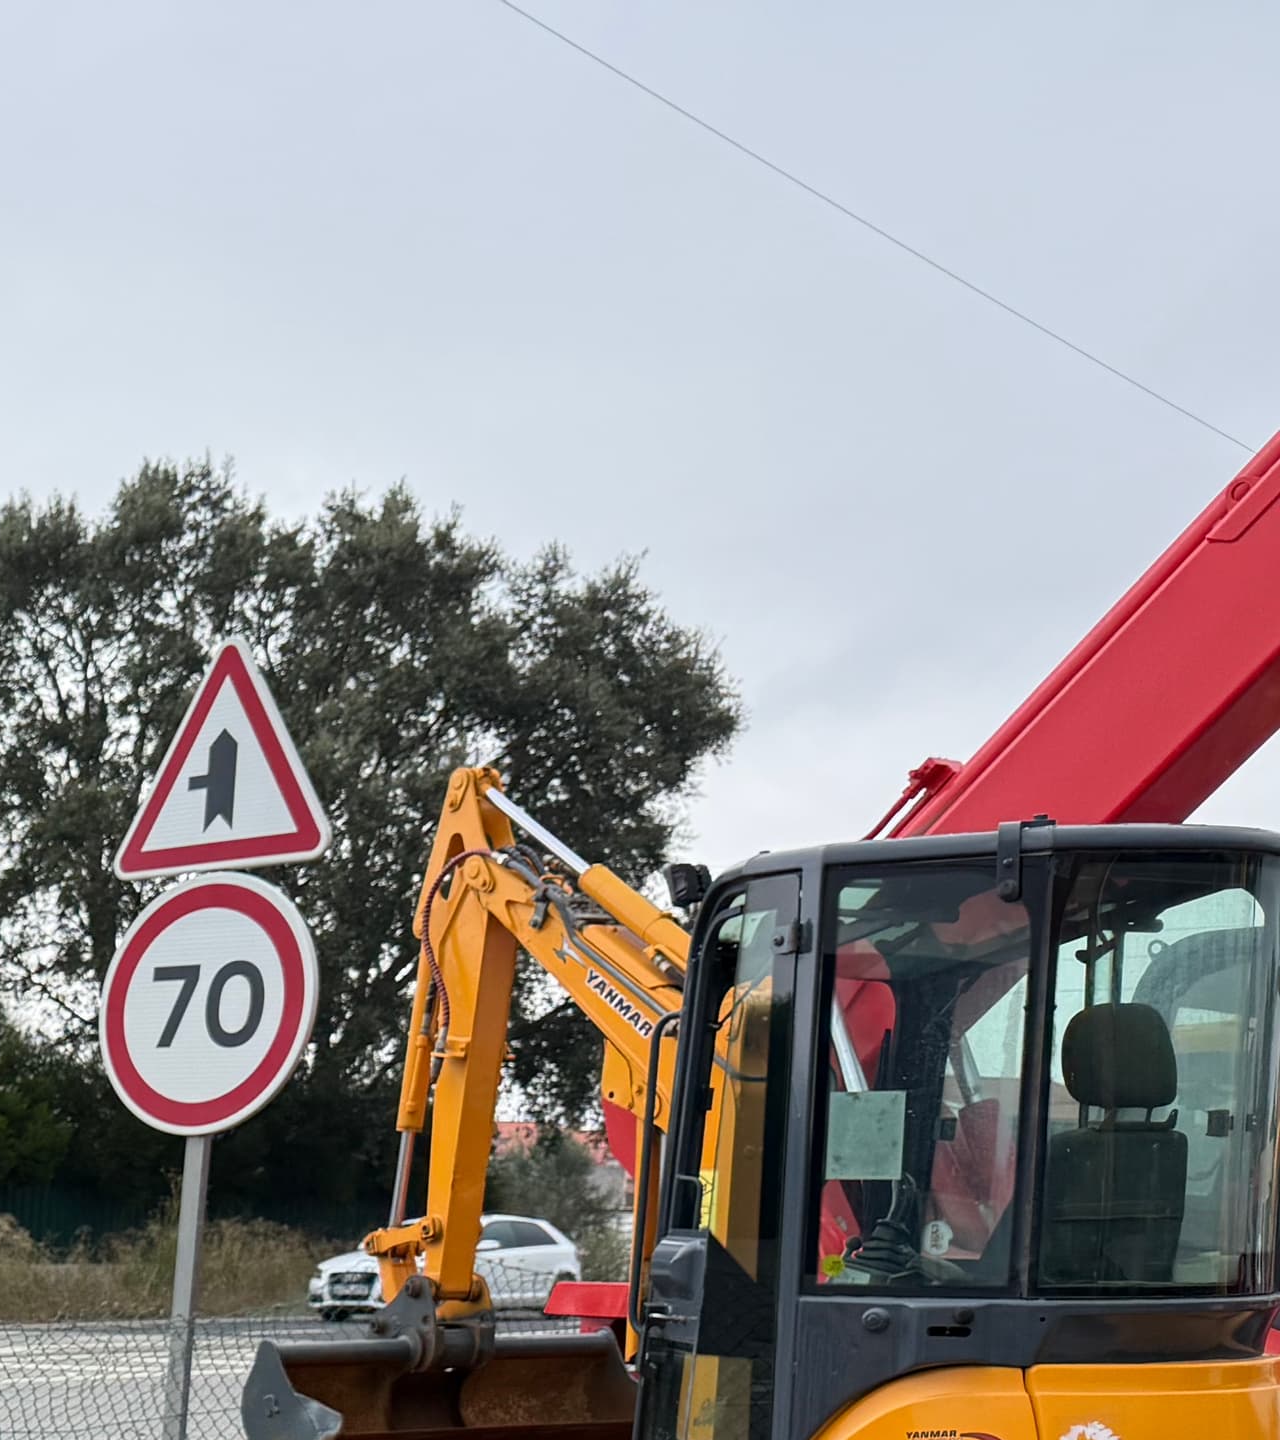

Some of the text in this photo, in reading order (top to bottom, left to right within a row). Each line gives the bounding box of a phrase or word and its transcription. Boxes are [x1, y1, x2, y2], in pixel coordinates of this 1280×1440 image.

[153, 960, 265, 1048] 70
[586, 968, 654, 1037] YANMAR
[906, 1430, 957, 1439] YANMAR
